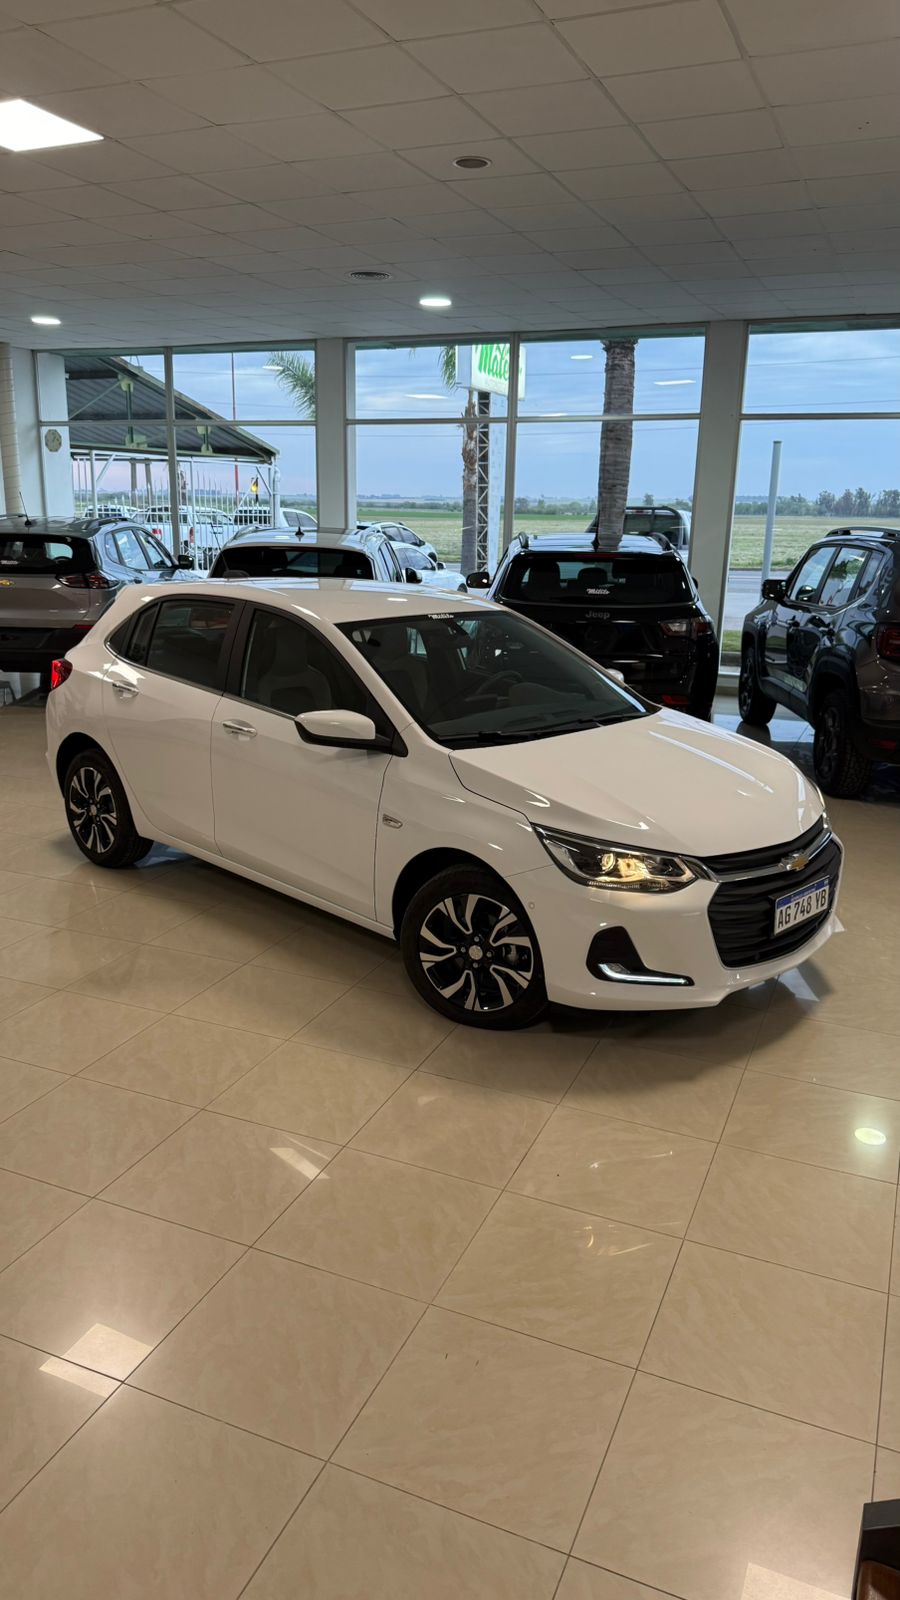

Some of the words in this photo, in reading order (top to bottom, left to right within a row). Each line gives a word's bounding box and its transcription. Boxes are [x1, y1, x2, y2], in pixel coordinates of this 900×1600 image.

[585, 610, 611, 620] Jeep
[777, 905, 792, 929] AG
[793, 895, 812, 921] 748
[815, 889, 827, 910] YB
